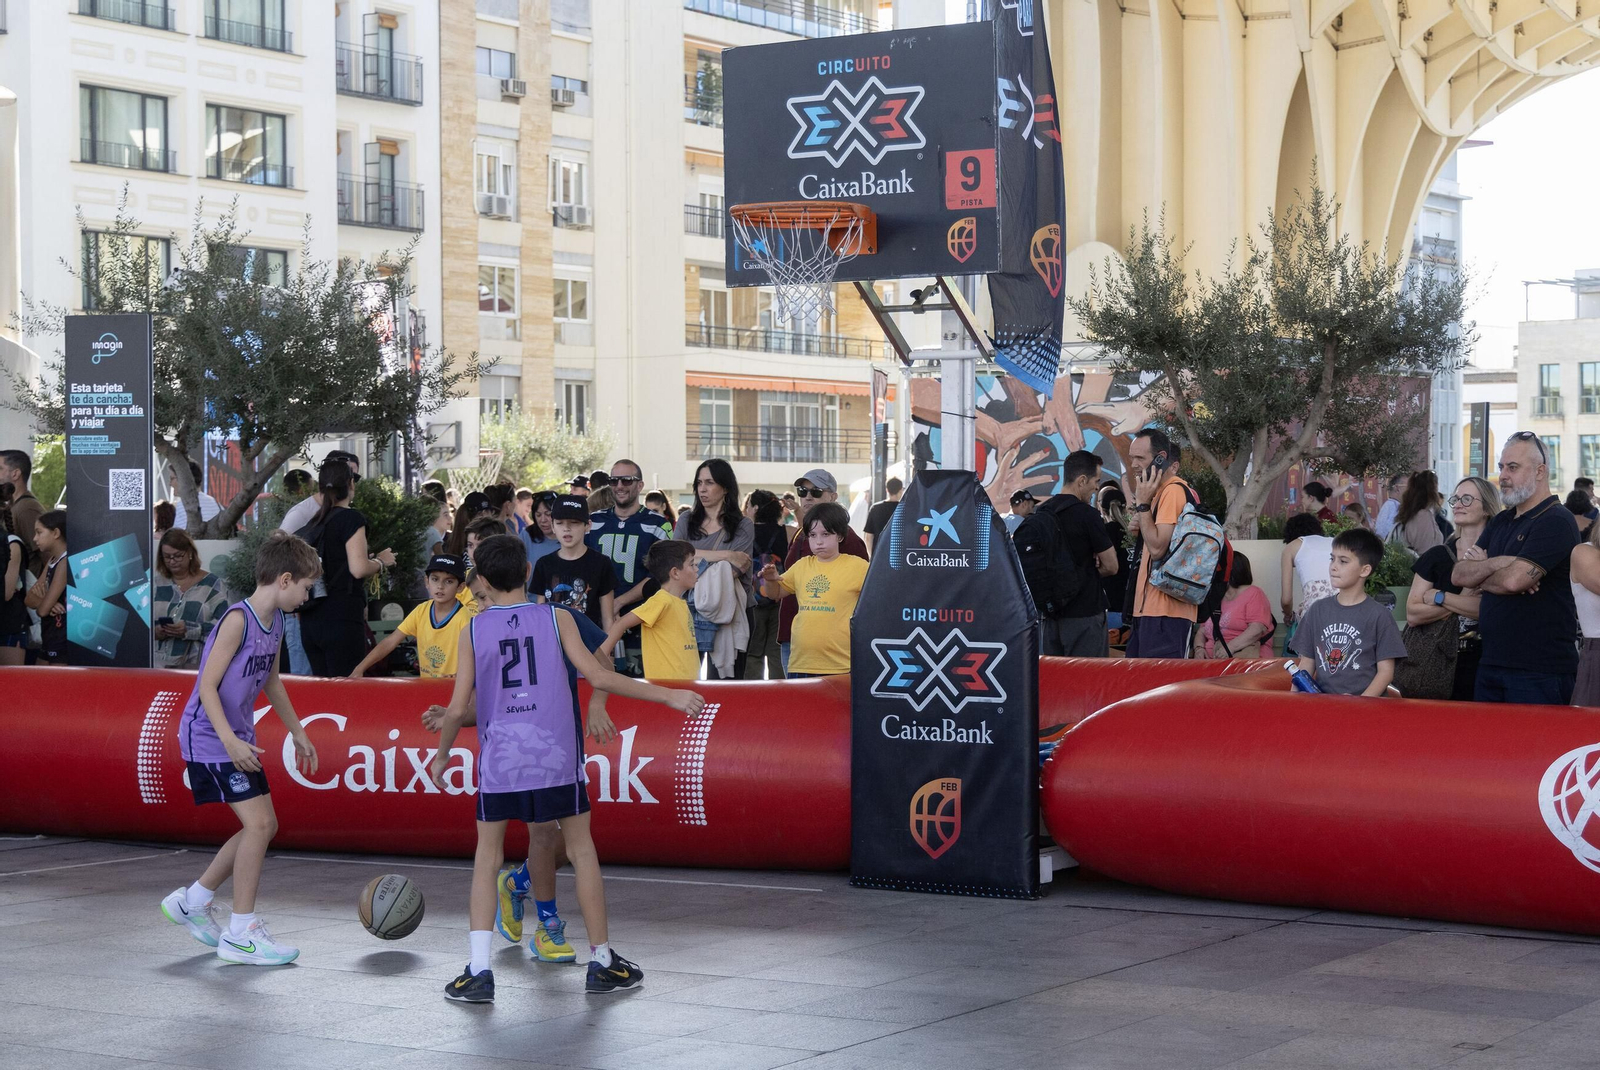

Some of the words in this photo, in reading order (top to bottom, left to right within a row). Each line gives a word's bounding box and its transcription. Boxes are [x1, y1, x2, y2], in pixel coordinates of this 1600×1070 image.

[817, 55, 891, 76] CIRCUITO
[960, 156, 981, 192] 9
[798, 168, 915, 200] CaixaBank
[71, 383, 91, 393] Esta
[93, 382, 123, 394] tarjeta
[71, 395, 80, 404] te
[83, 395, 94, 404] da
[96, 394, 132, 404] cancha:
[71, 407, 92, 417] para
[93, 406, 103, 415] tu
[105, 404, 119, 415] día
[121, 407, 127, 415] a
[129, 404, 144, 415] día
[71, 418, 77, 429] y
[79, 416, 105, 429] viajar
[598, 533, 639, 583] 14
[906, 552, 969, 568] CaixaBank
[902, 608, 974, 623] CIRCUITO
[1323, 622, 1360, 639] HELLFIRE
[1330, 635, 1348, 644] CLUB
[499, 636, 538, 689] 21
[506, 703, 537, 713] SEVILLA
[881, 714, 994, 744] CaixaBank
[282, 713, 660, 804] Caixank
[940, 782, 958, 791] FEB
